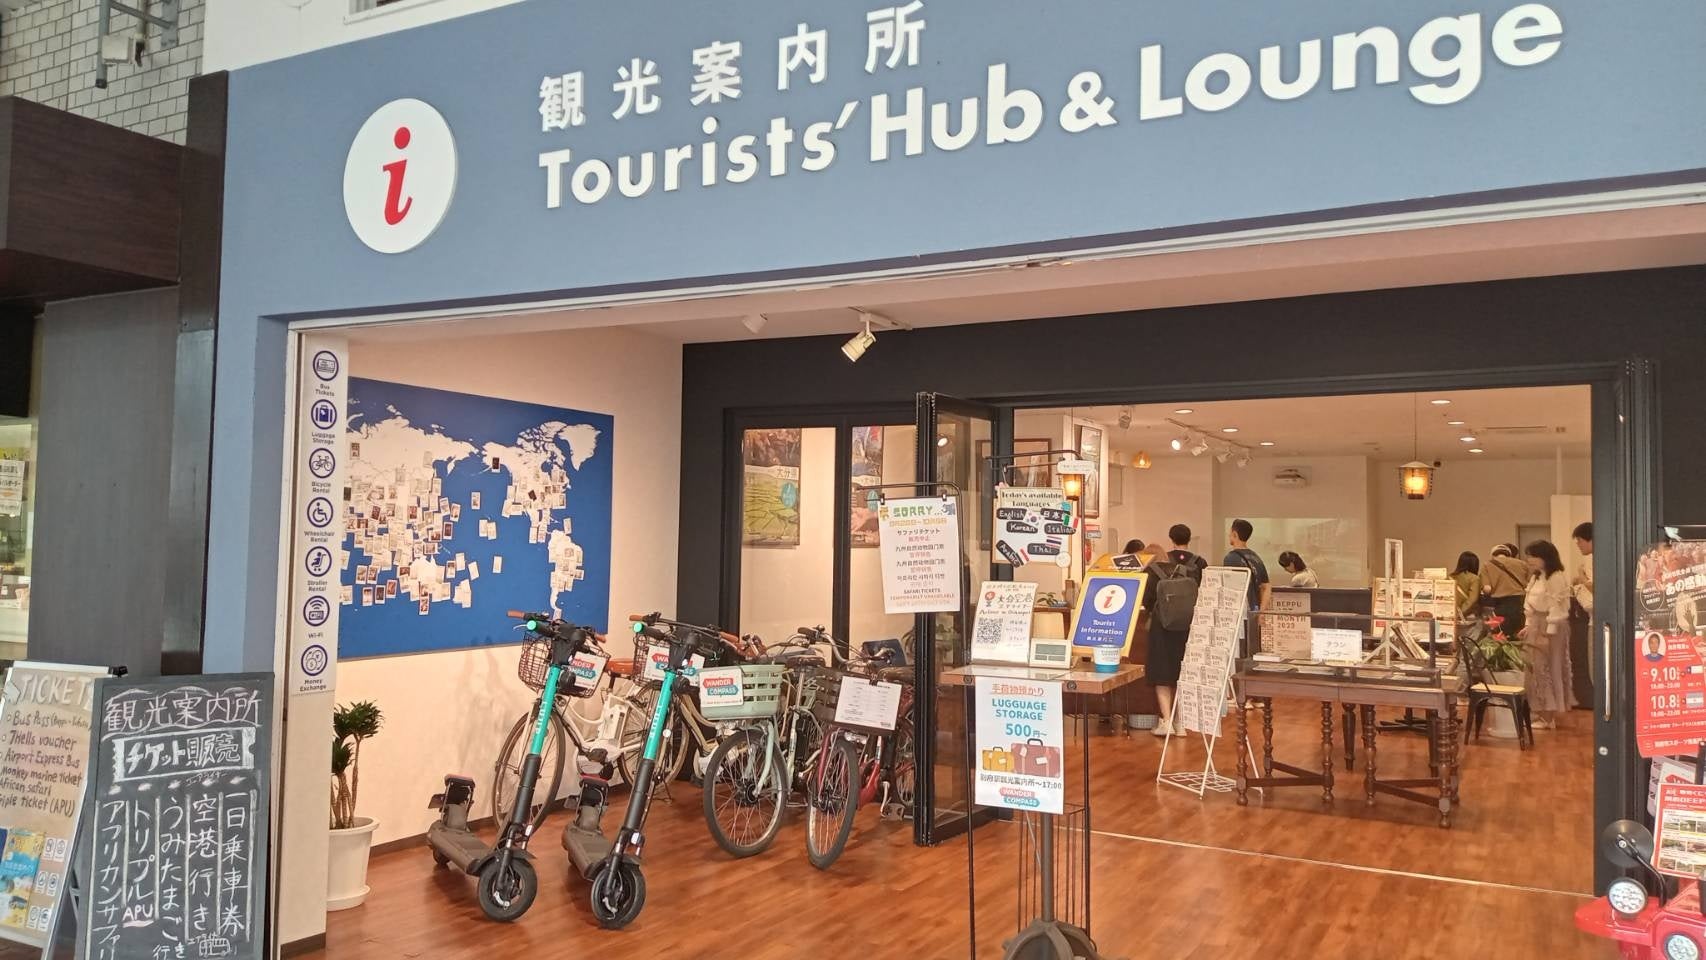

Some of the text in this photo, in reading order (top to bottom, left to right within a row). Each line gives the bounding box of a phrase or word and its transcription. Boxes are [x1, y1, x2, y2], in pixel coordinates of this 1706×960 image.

[538, 1, 926, 132] 観光案内所
[869, 63, 1043, 162] Hub
[1059, 71, 1117, 133] &
[1140, 3, 1563, 121] Lounge
[999, 510, 1025, 520] English
[1010, 523, 1036, 532] Korean
[1047, 525, 1075, 533] Italian
[1033, 545, 1052, 553] Thai
[1080, 627, 1123, 635] Information
[1650, 667, 1678, 681] 9.10
[299, 684, 327, 692] Exchange
[705, 679, 732, 687] WANDER
[709, 687, 736, 695] COMPASS
[992, 698, 1047, 711] LUGGUAGE
[1651, 694, 1677, 709] 10.8
[13, 710, 31, 726] Bus
[104, 690, 262, 733] 観光案内所
[996, 709, 1043, 721] STORAGE
[40, 736, 77, 752] voucher
[5, 748, 80, 769] Airport Express Bus
[126, 733, 241, 775] チケット販売
[31, 770, 57, 783] marine
[28, 781, 52, 797] safari
[49, 798, 76, 818] (APU)
[188, 793, 218, 931] 空港行き
[220, 791, 248, 937] 一日乗車券
[122, 903, 154, 921] APU
